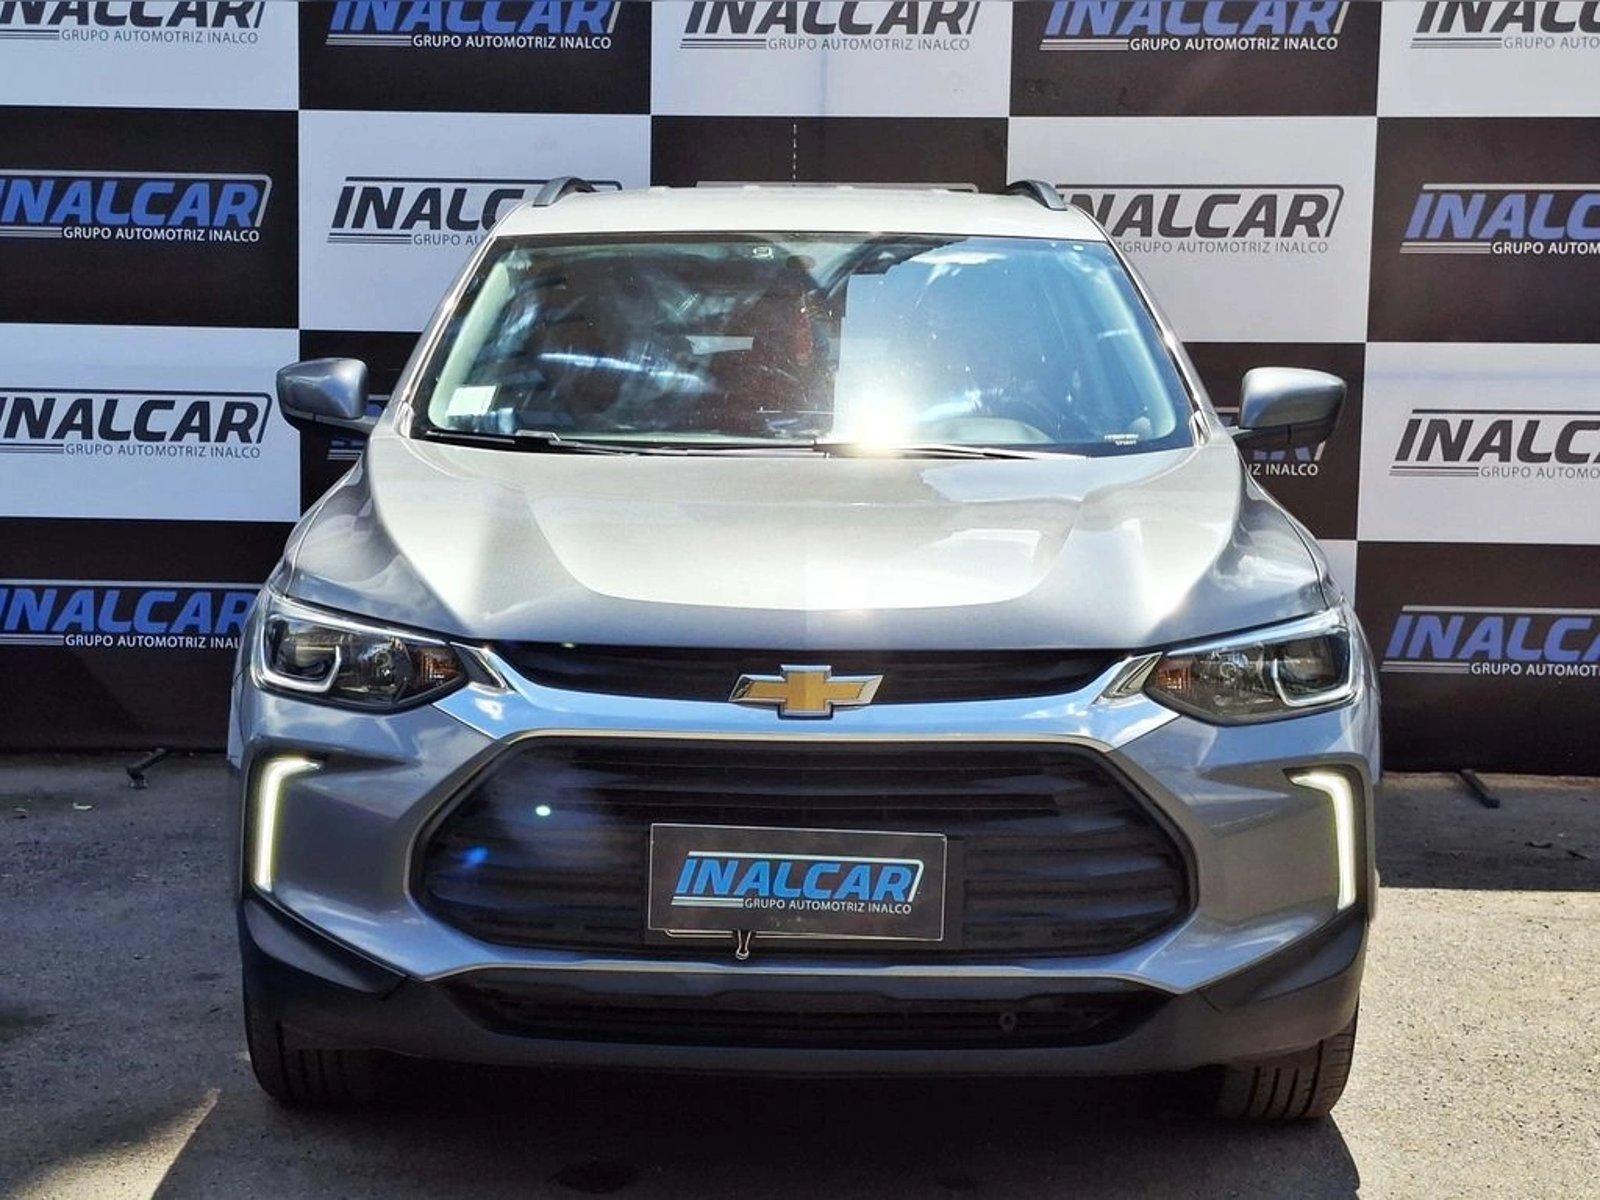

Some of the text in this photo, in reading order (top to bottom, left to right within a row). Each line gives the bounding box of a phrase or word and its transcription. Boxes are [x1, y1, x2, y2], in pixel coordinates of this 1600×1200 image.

[62, 30, 258, 44] GRUPO AUTOMOTRIZ INALCO
[413, 34, 611, 49] GRUPO AUTOMOTRIZ INALCO
[768, 38, 969, 50] GRUPO AUTOMOTRIZ INALCO
[1131, 37, 1338, 50] GRUPO AUTOMOTRIZ INALCO
[1504, 36, 1555, 49] GRUPO
[0, 179, 259, 227] NALCAR
[64, 227, 260, 242] GRUPO AUTOMOTRIZ INALCO
[413, 234, 460, 246] GRUPO
[1125, 241, 1328, 253] GRUPO AUTOMOTRIZ INALCO
[1492, 242, 1544, 254] GRUPO
[0, 396, 259, 443] NALCAR
[1394, 419, 1600, 464] INALC
[65, 443, 260, 458] GRUPO AUTOMOTRIZ INALCO
[1265, 464, 1318, 476] INALCO
[1481, 466, 1531, 479] GRUPO
[0, 588, 257, 634] NALCAR
[65, 634, 113, 647] GRUPO
[117, 635, 206, 649] AUTOMOTRIZ
[1471, 663, 1600, 677] GRUPO AUTOMOT
[675, 858, 912, 902] INALCAR
[744, 898, 912, 915] GRUPO AUTOMOTRIZ INALCO
